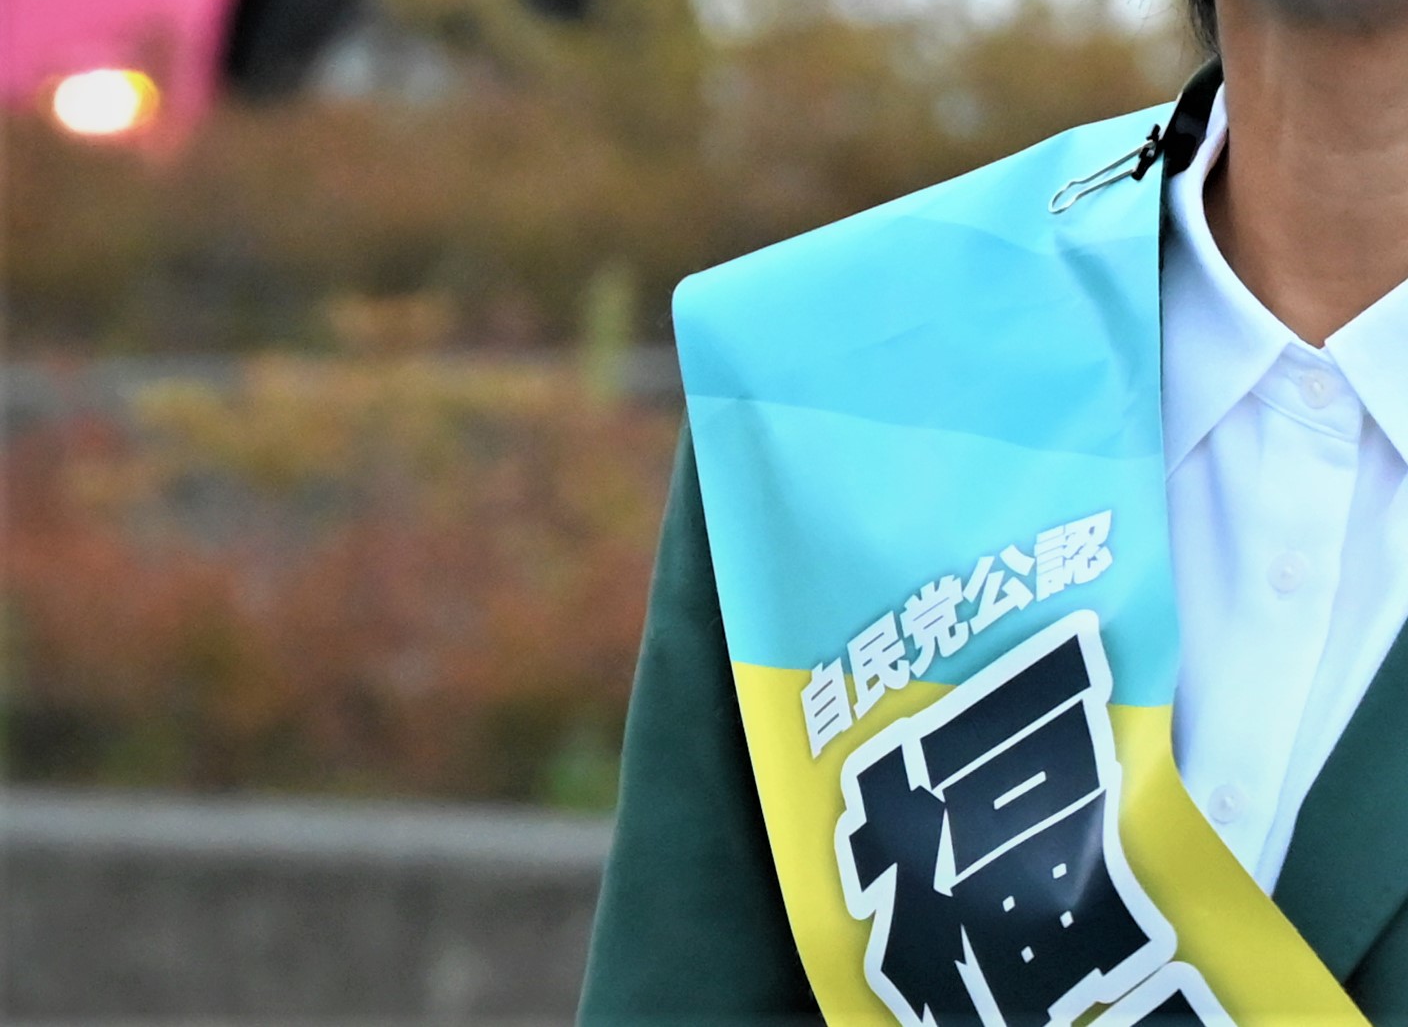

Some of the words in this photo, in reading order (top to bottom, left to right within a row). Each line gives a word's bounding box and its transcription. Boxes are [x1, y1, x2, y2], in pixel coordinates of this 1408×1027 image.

[800, 510, 1113, 759] 自民党公認
[842, 618, 1212, 1027] 福
